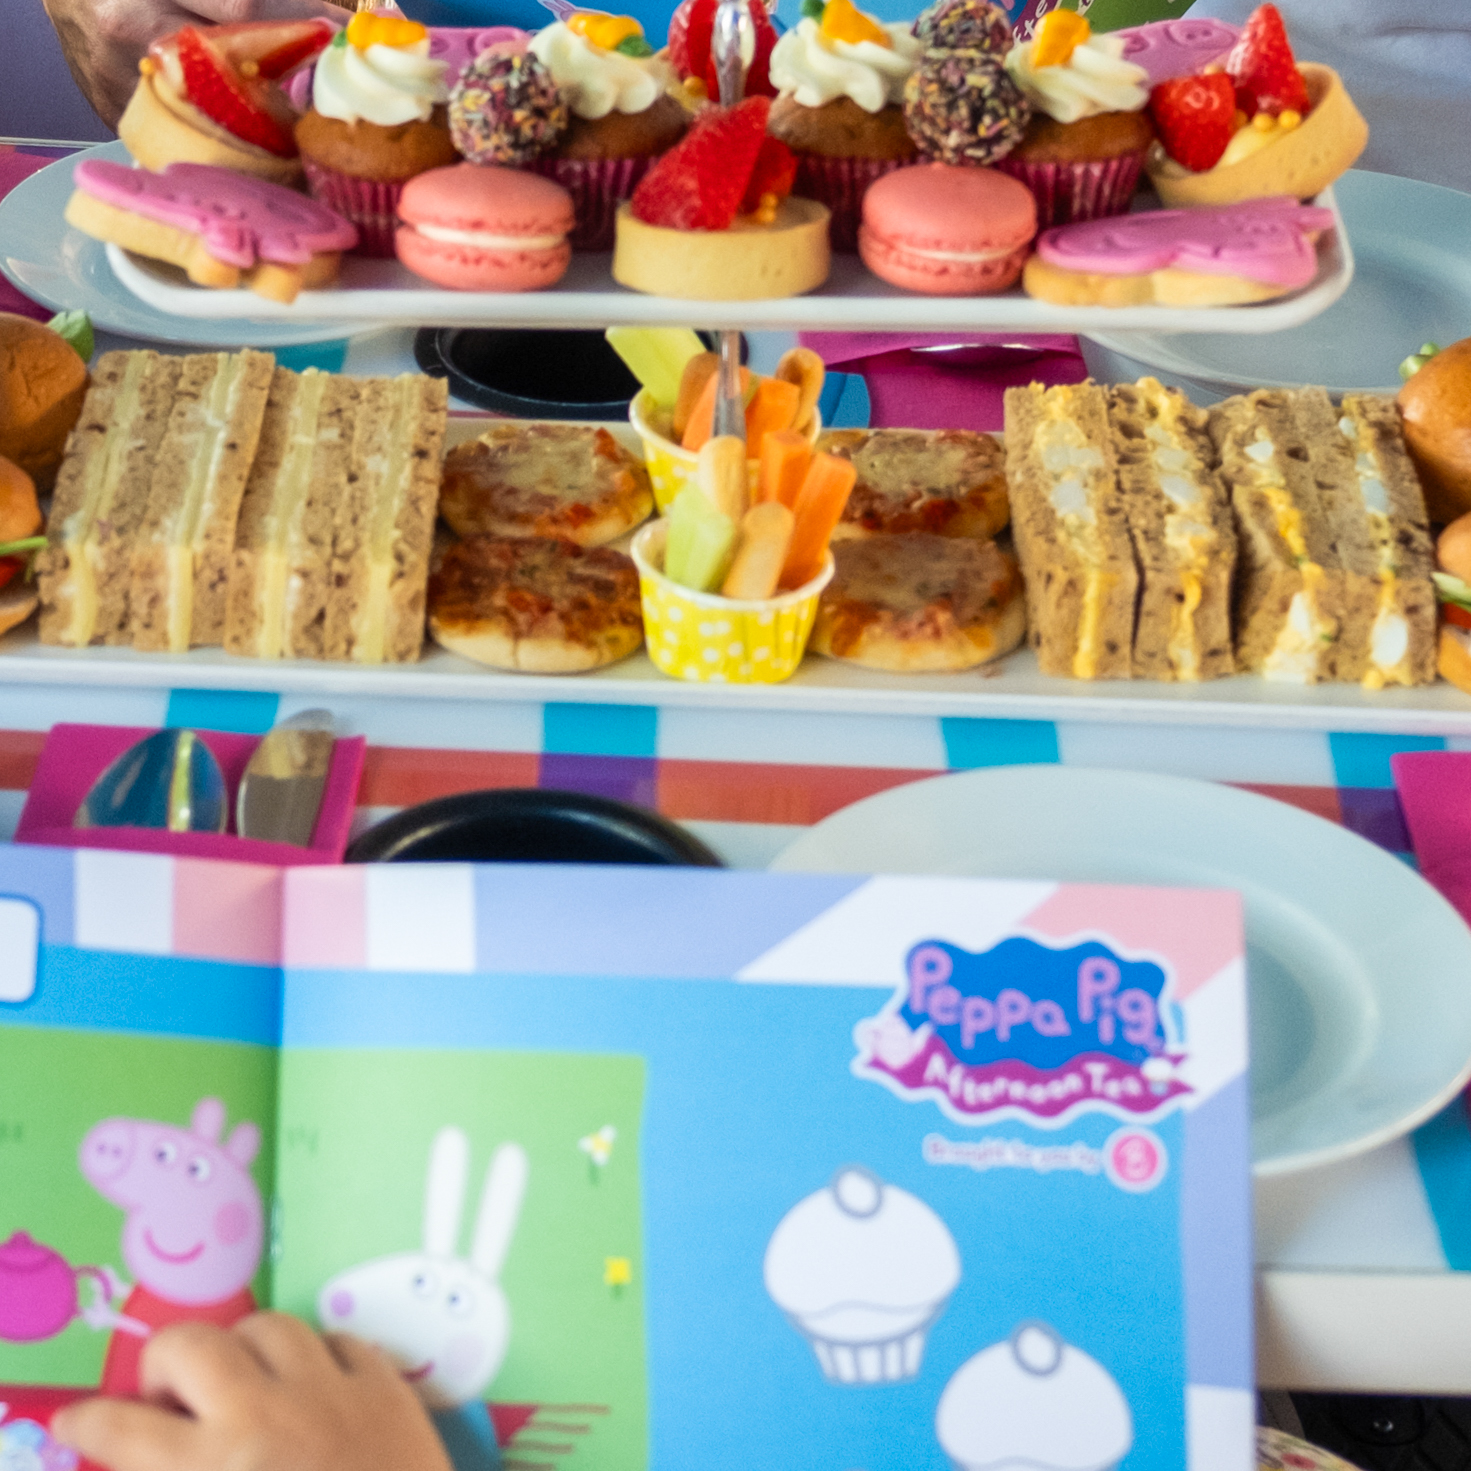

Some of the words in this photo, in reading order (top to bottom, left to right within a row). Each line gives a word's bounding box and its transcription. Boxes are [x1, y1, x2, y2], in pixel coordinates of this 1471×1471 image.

[908, 945, 1073, 1050] Peppa
[1078, 955, 1158, 1046] Pig
[924, 1052, 1083, 1106] Afternoon
